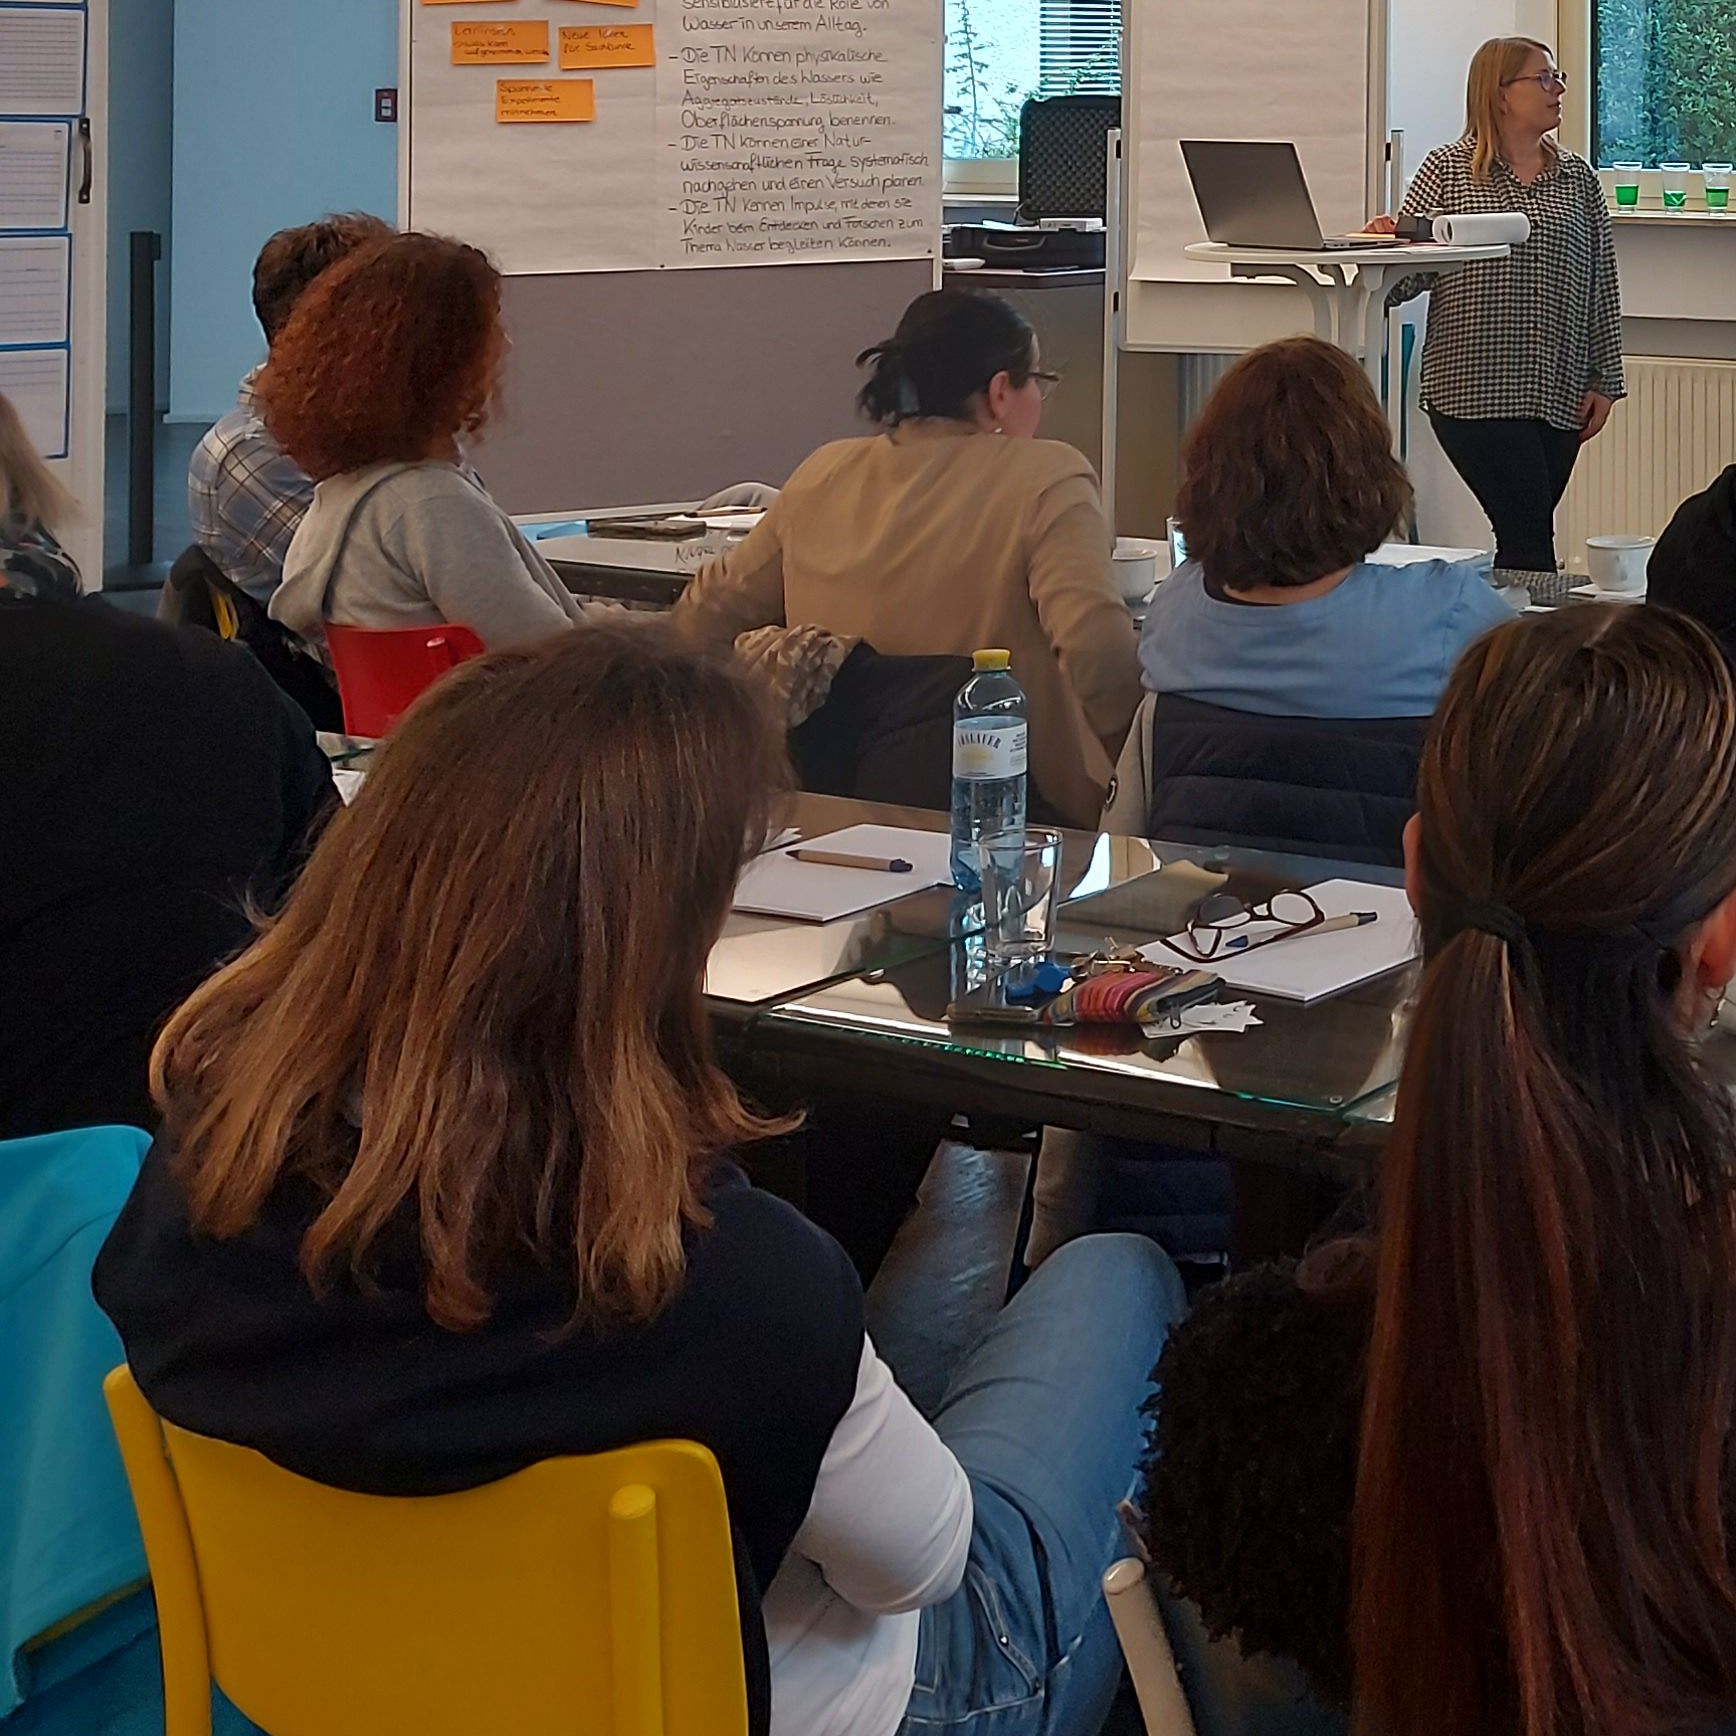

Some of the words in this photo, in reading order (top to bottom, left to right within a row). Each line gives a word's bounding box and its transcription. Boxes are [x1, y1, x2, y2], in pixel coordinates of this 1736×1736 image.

[682, 15, 737, 32] Wasser
[739, 16, 755, 30] in
[815, 14, 868, 38] Alltag.
[681, 46, 709, 63] Die
[710, 45, 737, 64] TN
[772, 68, 798, 85] des
[859, 72, 883, 84] wie
[680, 134, 709, 151] Die
[710, 133, 736, 150] TN
[762, 175, 786, 192] und
[824, 171, 880, 190] Versuch
[680, 199, 711, 215] Die
[711, 197, 736, 214] TN
